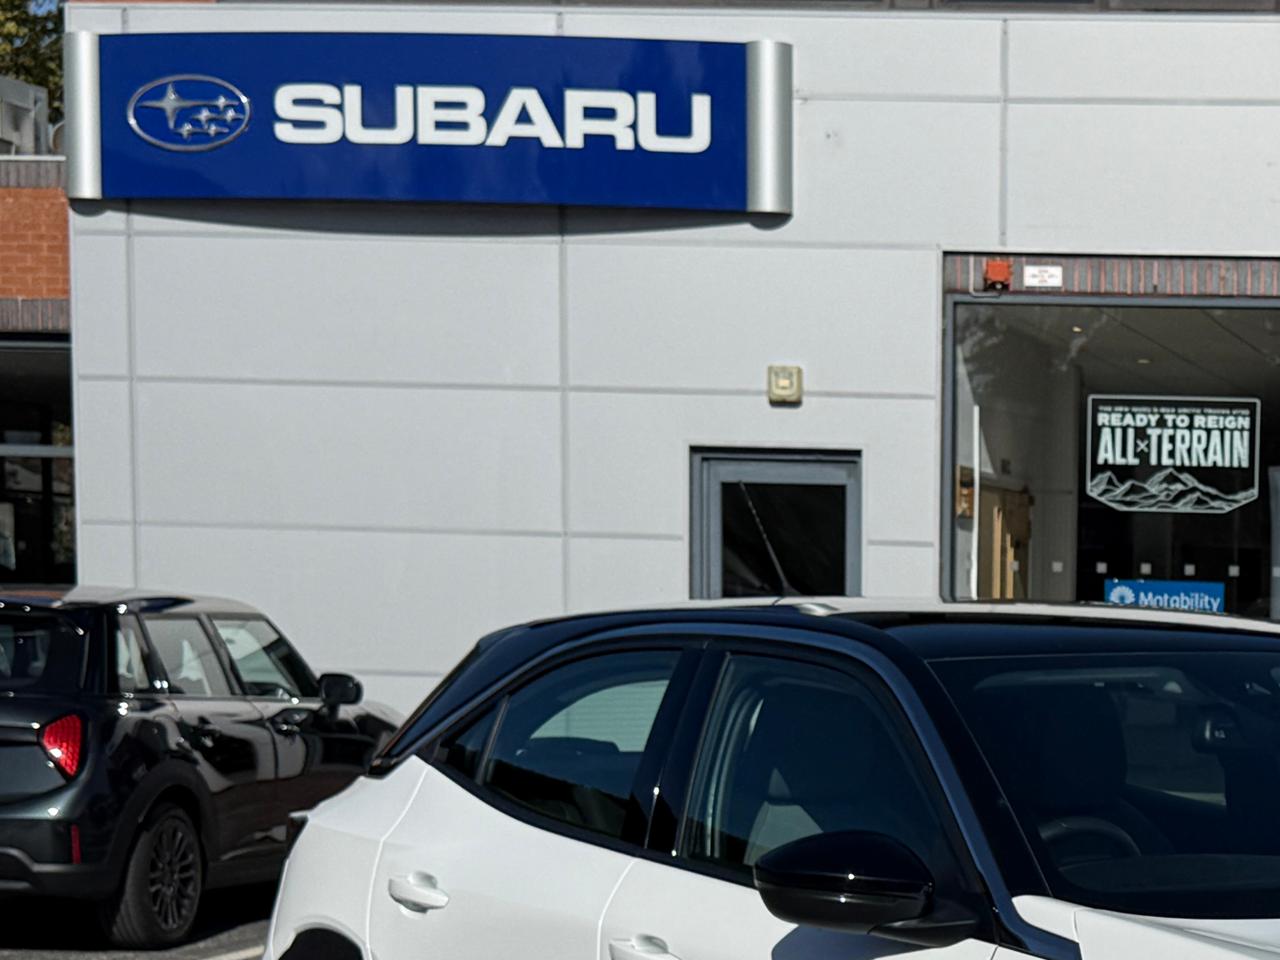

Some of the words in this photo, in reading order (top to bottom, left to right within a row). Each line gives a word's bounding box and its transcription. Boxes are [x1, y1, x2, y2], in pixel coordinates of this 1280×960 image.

[273, 82, 711, 154] SUBARU
[1097, 412, 1159, 427] READY
[1164, 414, 1190, 428] TO
[1193, 415, 1250, 430] REIGN
[1138, 591, 1221, 612] Motability
